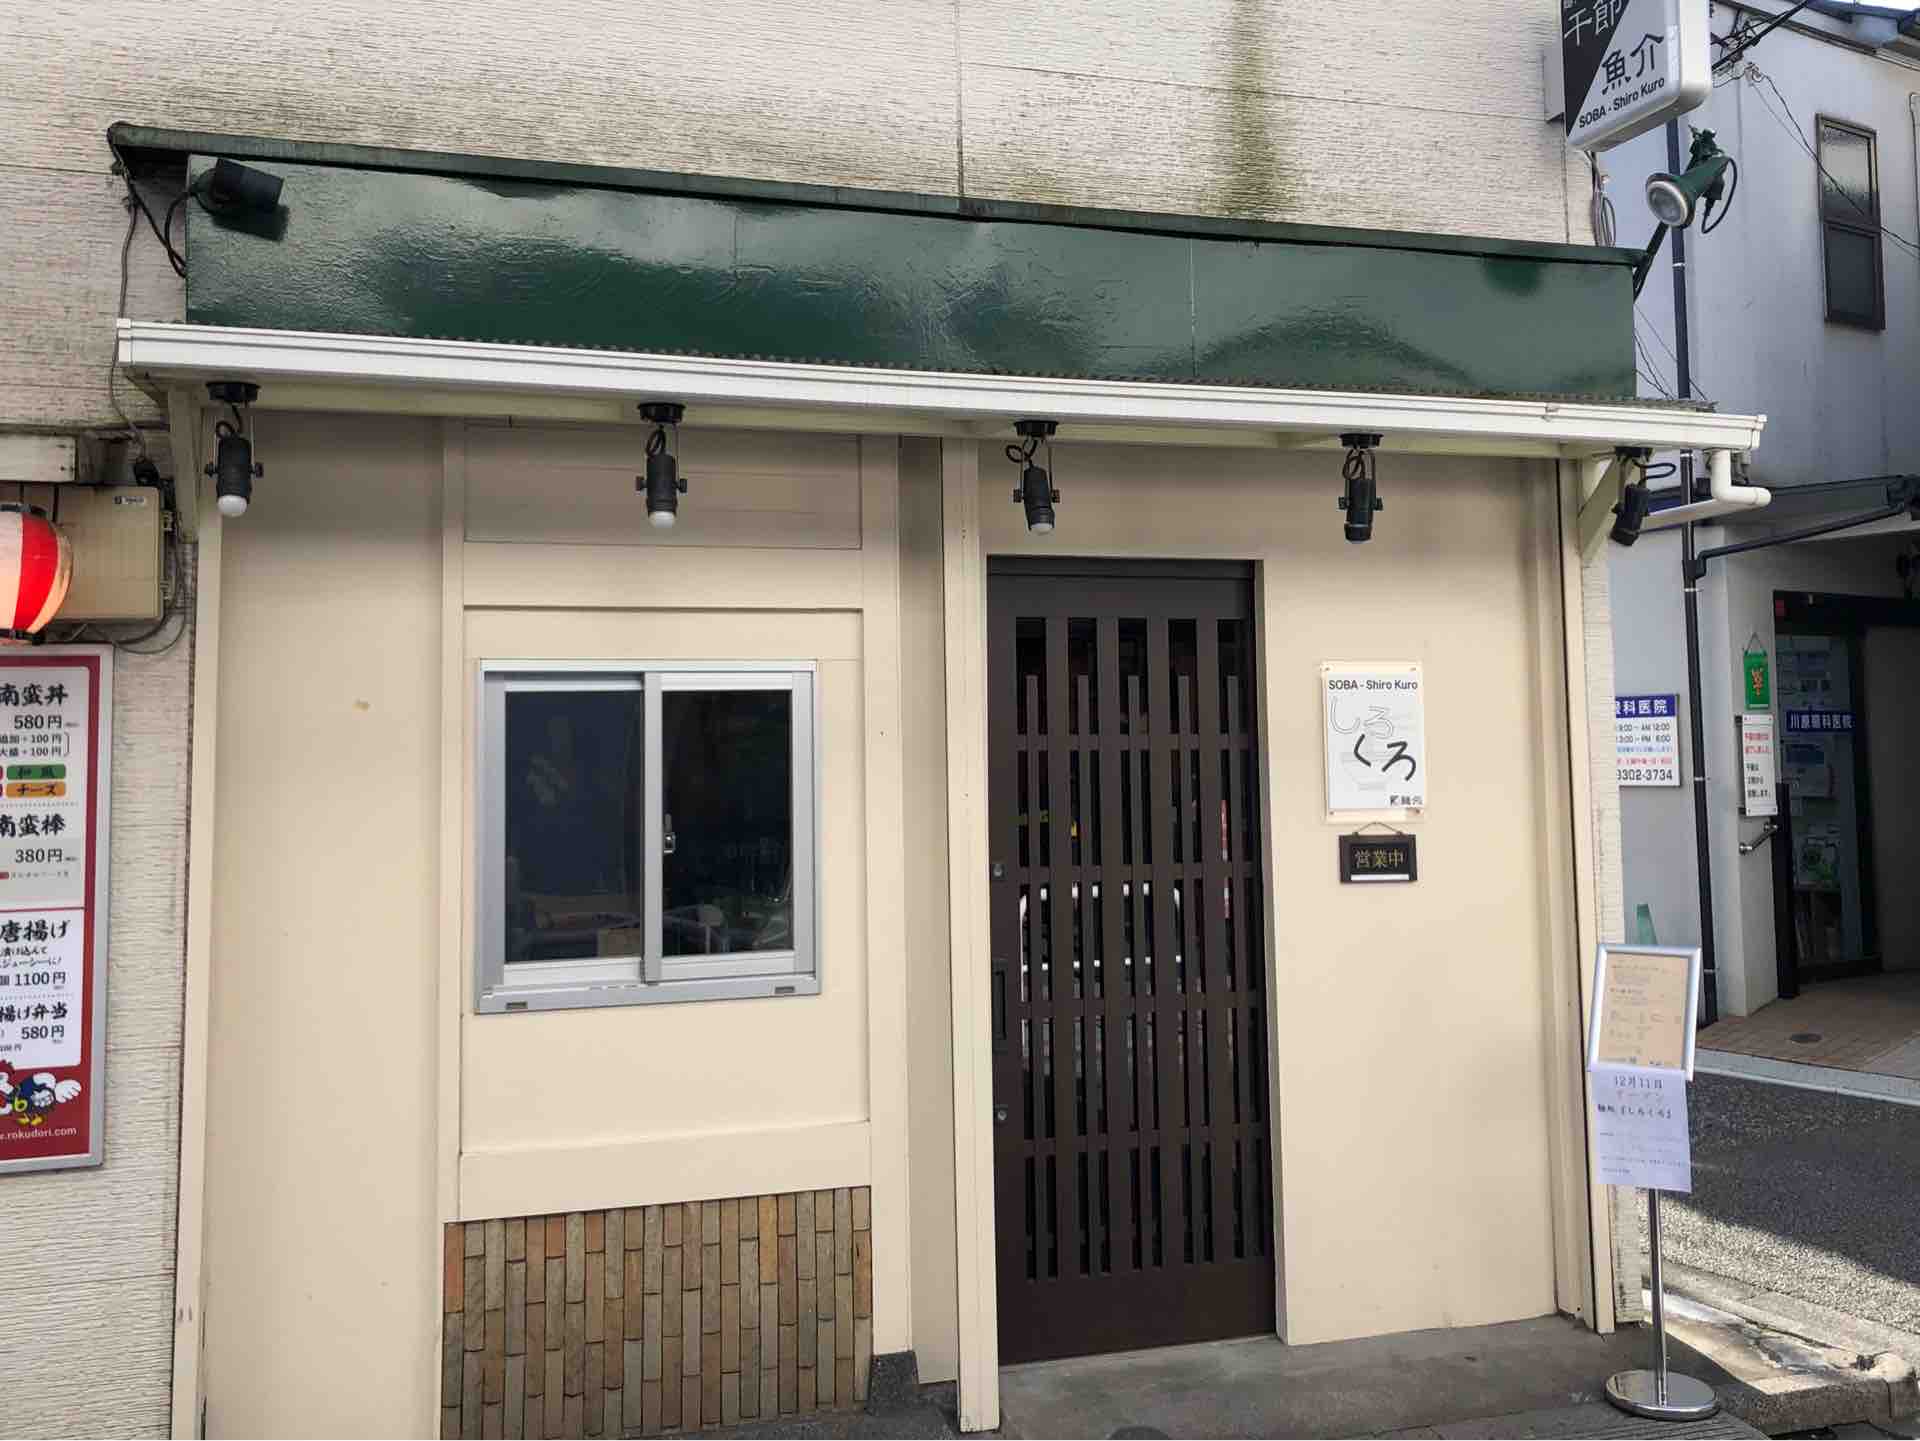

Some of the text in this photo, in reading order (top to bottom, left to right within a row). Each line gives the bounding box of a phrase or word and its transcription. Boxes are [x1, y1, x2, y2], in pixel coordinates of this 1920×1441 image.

[1602, 32, 1664, 95] 魚介
[1579, 105, 1607, 128] SOBA
[1613, 90, 1639, 111] Shiro
[1640, 77, 1665, 96] Kuro
[0, 683, 69, 706] 南蛮丼
[1328, 680, 1358, 690] SOBA
[1366, 679, 1392, 690] Shiro
[1394, 679, 1418, 690] Kuro
[14, 714, 62, 729] 580円
[1330, 696, 1395, 740] しろ
[1353, 734, 1417, 781] くろ
[16, 784, 56, 797] チーズ
[15, 848, 63, 863] 380円
[1354, 848, 1404, 869] 営業中
[0, 919, 70, 943] 唐揚げ
[14, 971, 66, 986] 1100円
[21, 1024, 64, 1040] 580円
